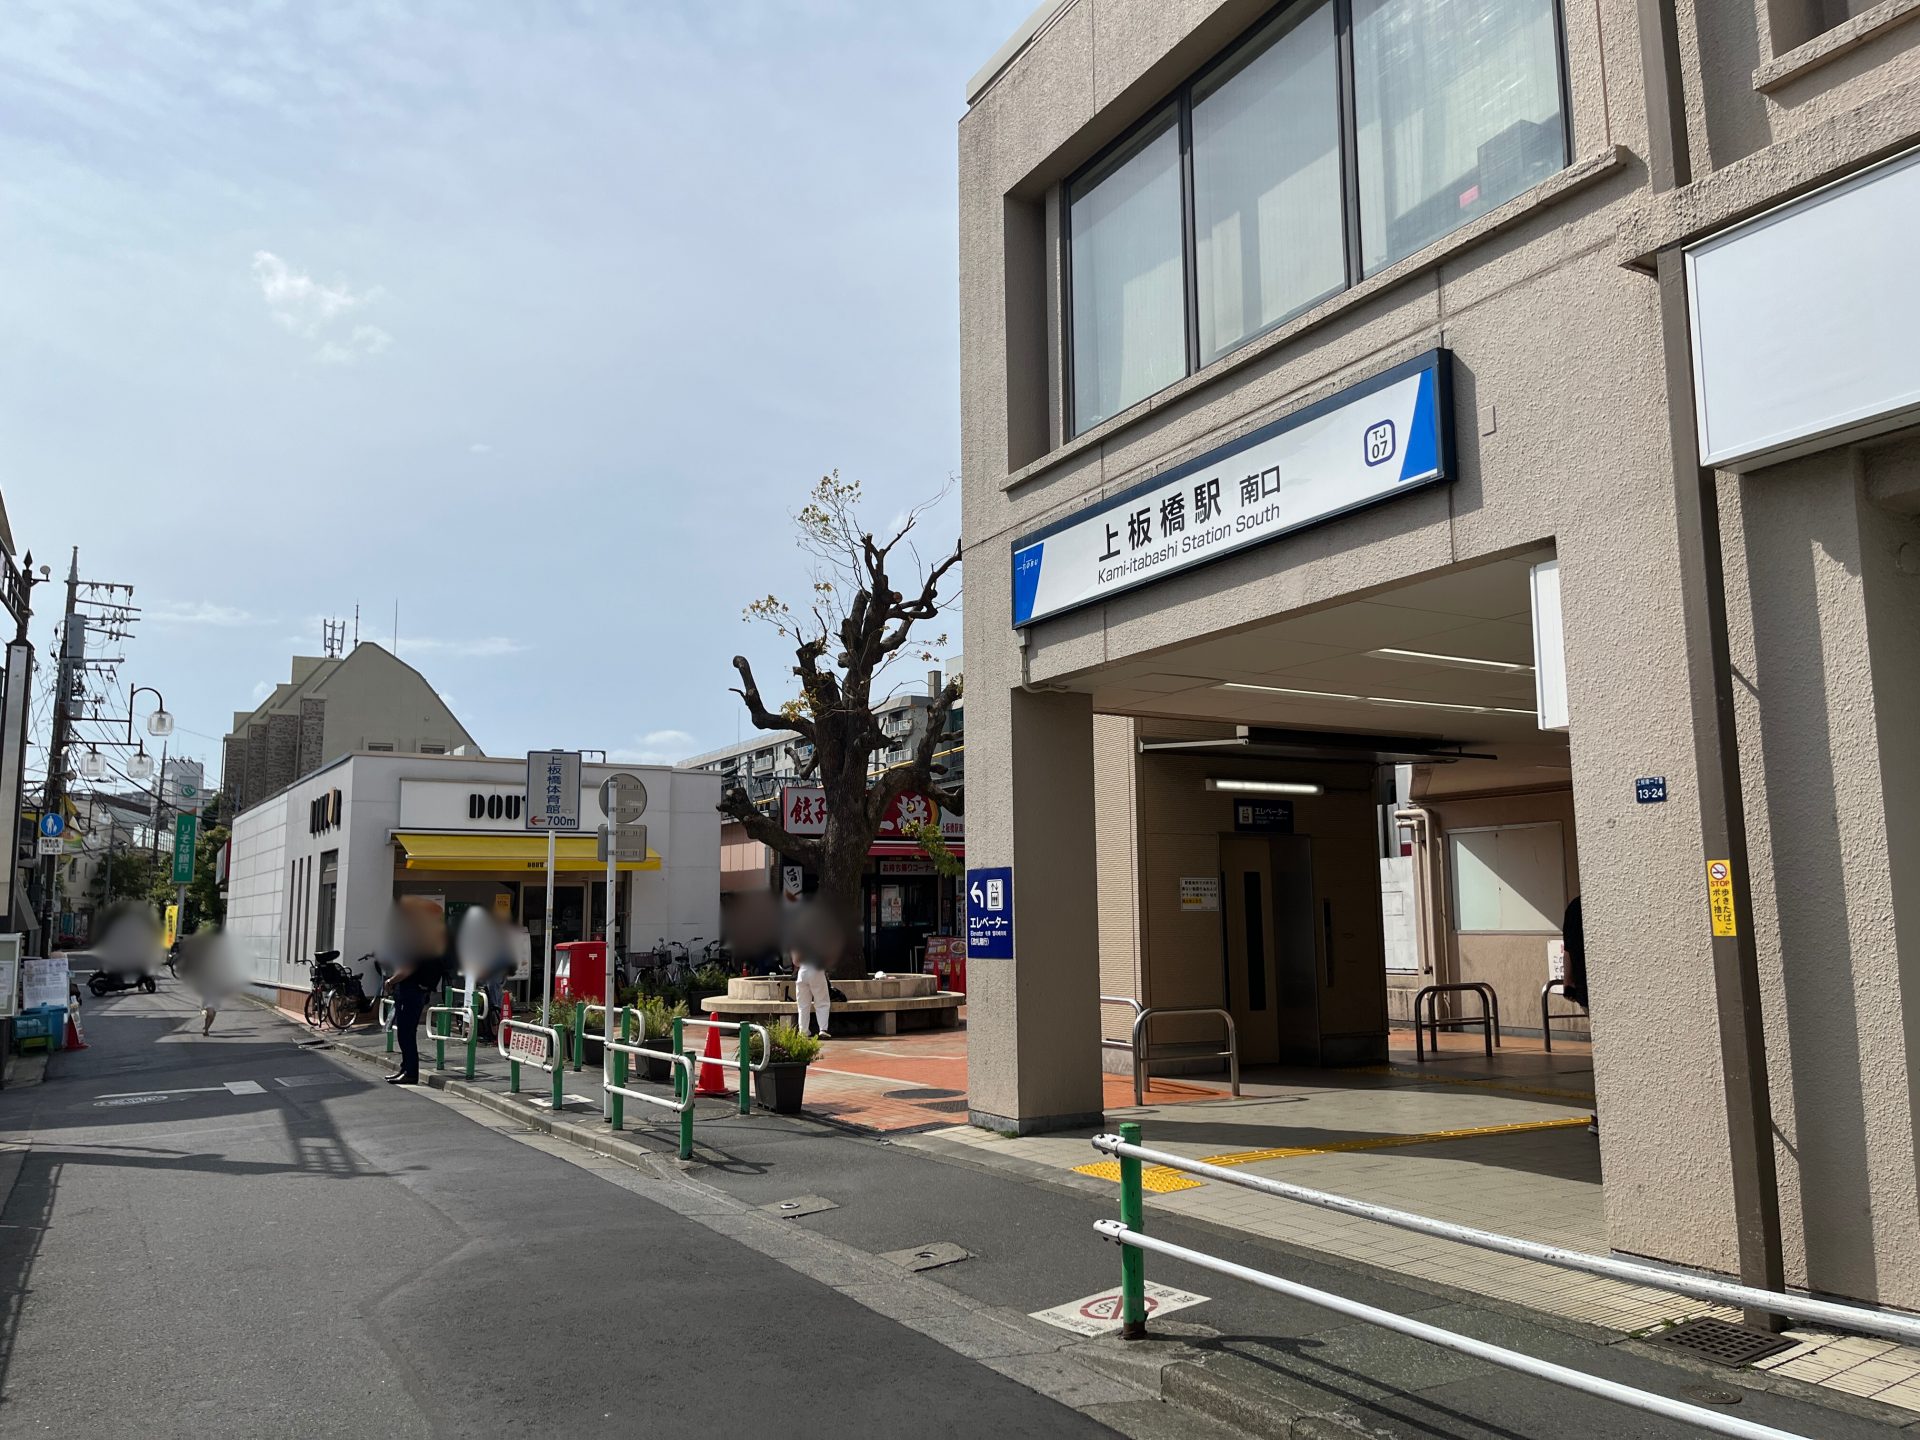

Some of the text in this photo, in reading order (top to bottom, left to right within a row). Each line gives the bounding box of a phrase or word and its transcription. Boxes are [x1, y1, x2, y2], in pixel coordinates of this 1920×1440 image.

[1372, 427, 1386, 440] TJ
[1372, 440, 1388, 459] 07
[1099, 465, 1281, 562] 上板橋駅 南口
[1098, 503, 1280, 585] Kami-itabashi Station South
[545, 756, 562, 815] 上板橋体育館
[1638, 787, 1664, 799] 13-24
[469, 794, 525, 820] DOU
[547, 815, 576, 827] 700m
[178, 824, 191, 873] りそな銀行
[970, 916, 1008, 929] エレベーター
[1721, 888, 1732, 931] 歩きたばこ
